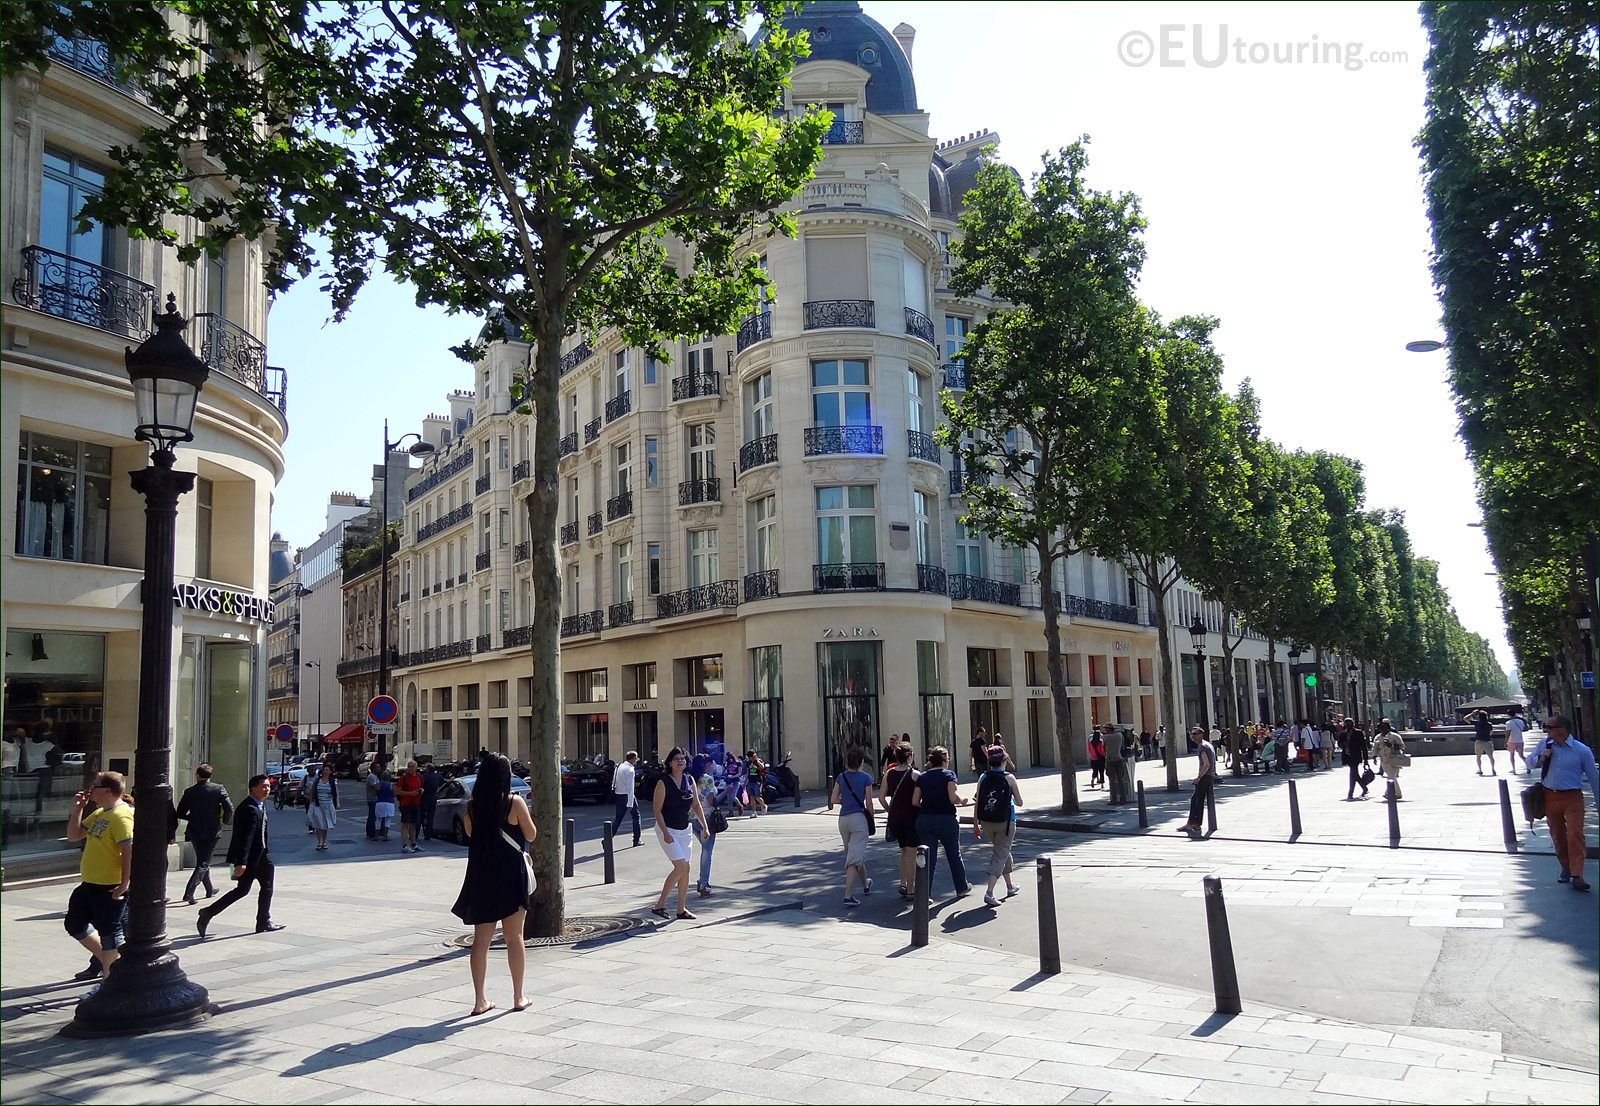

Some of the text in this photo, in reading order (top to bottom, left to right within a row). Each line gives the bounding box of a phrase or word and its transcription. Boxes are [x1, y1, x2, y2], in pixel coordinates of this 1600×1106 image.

[172, 584, 275, 623] ARKS&SPENCE
[823, 627, 879, 639] ZARA
[689, 699, 708, 707] ZARA
